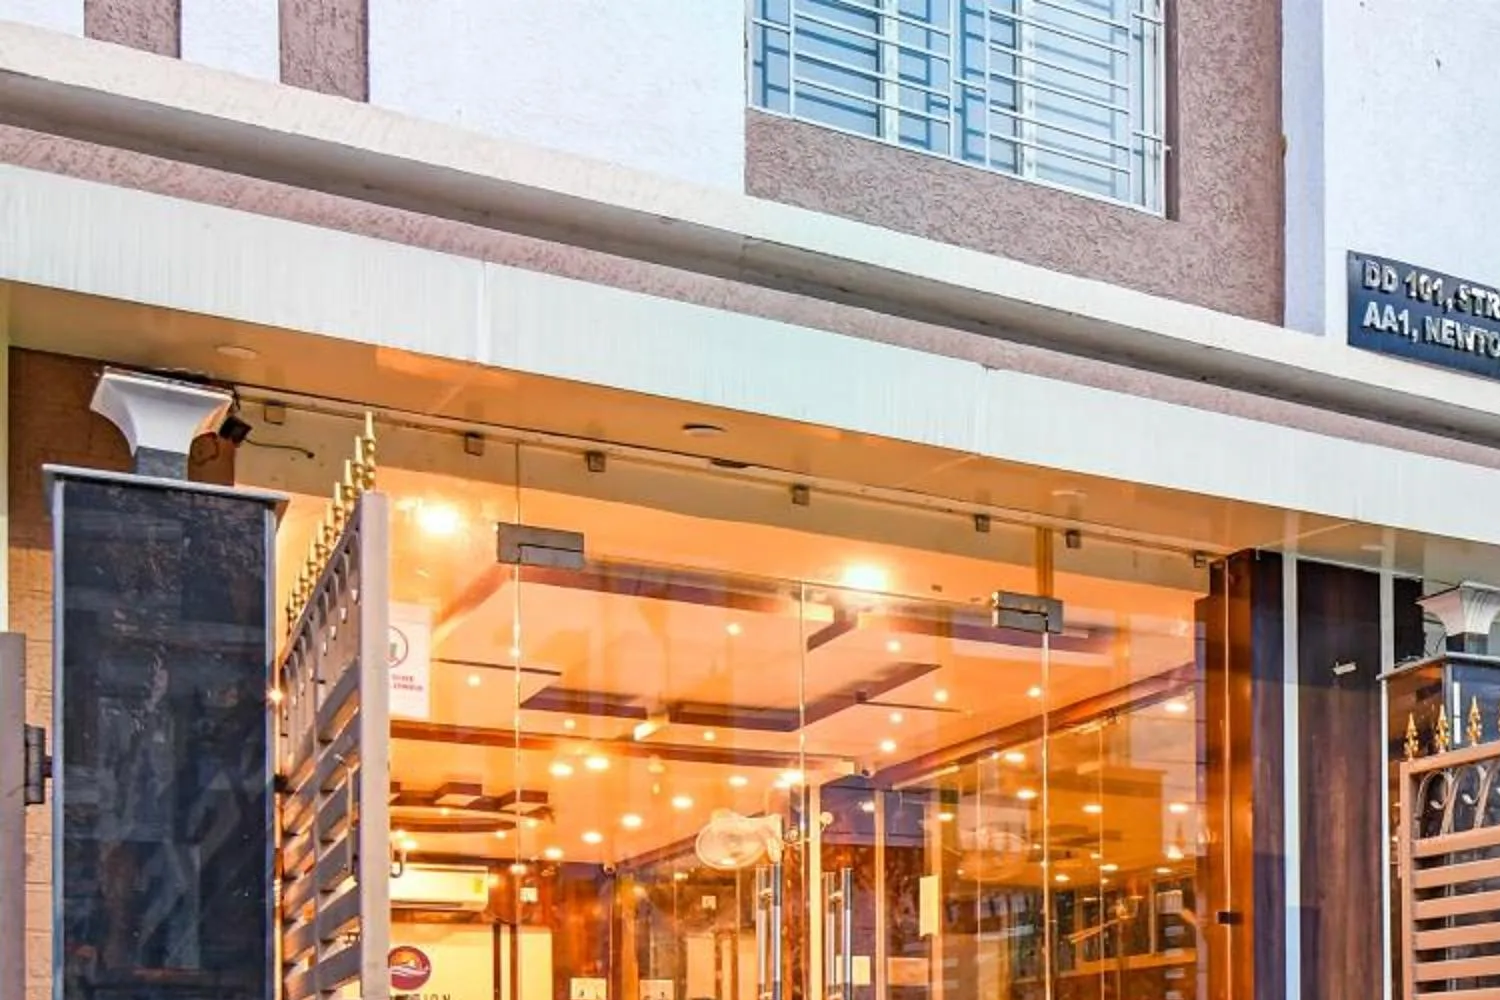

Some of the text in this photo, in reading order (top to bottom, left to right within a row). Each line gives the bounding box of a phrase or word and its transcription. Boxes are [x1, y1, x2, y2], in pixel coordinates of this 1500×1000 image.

[1363, 260, 1398, 294] DD
[1404, 271, 1453, 313] 101,
[1363, 302, 1419, 343] AA1,
